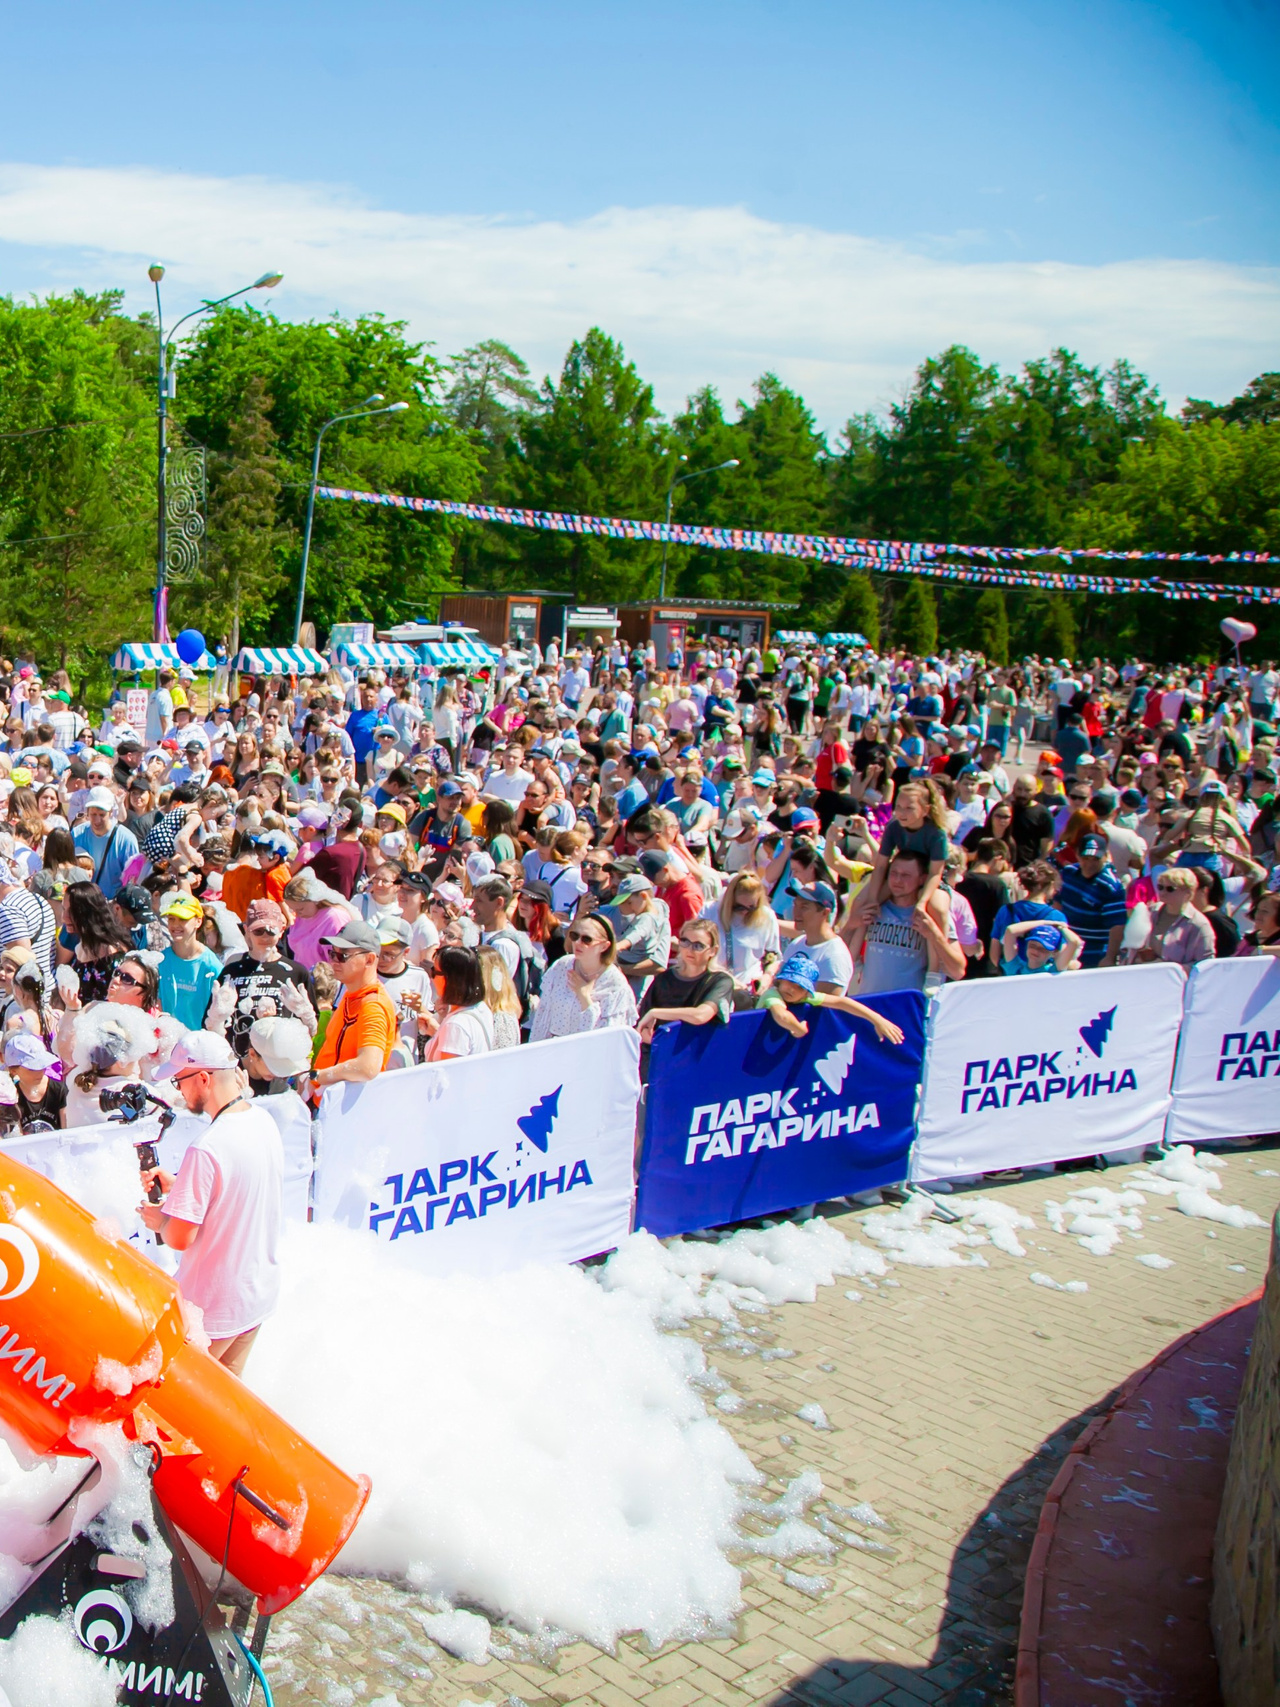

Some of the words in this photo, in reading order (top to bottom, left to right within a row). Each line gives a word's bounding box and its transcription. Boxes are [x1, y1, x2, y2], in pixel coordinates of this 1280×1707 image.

[867, 921, 923, 951] BROOKLYN
[1220, 1030, 1280, 1056] ПА
[961, 1068, 1137, 1114] ГАГАРИНА
[963, 1050, 1062, 1086] ПАРК
[685, 1102, 881, 1165] ГАГАРИНА
[689, 1087, 800, 1135] ПАРК
[369, 1159, 593, 1241] ГАГАРИНА
